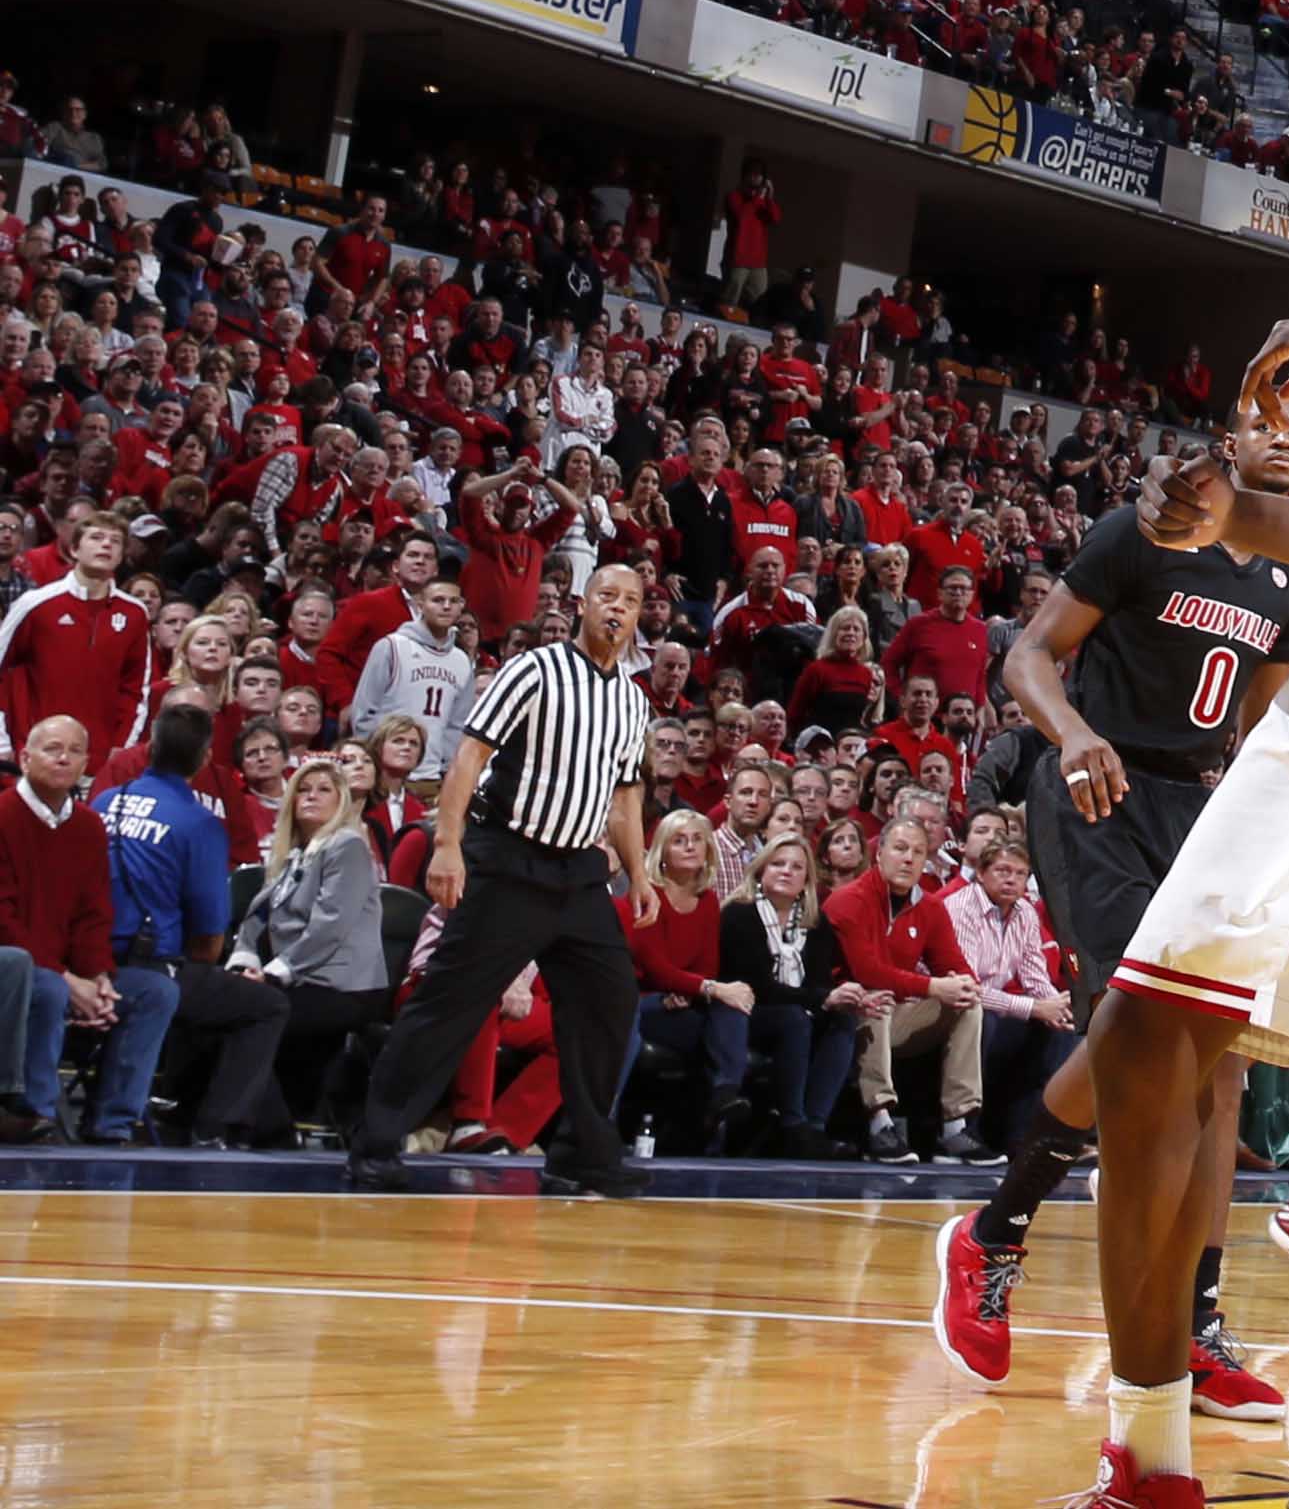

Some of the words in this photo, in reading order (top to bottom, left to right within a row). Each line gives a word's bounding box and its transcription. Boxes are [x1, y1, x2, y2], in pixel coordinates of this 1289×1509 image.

[828, 64, 866, 107] ipl
[1038, 135, 1150, 196] @Pacers
[1156, 591, 1281, 655] LOUISVILLE
[423, 685, 443, 718] 11
[1189, 646, 1239, 729] 0
[108, 793, 157, 818] ESG
